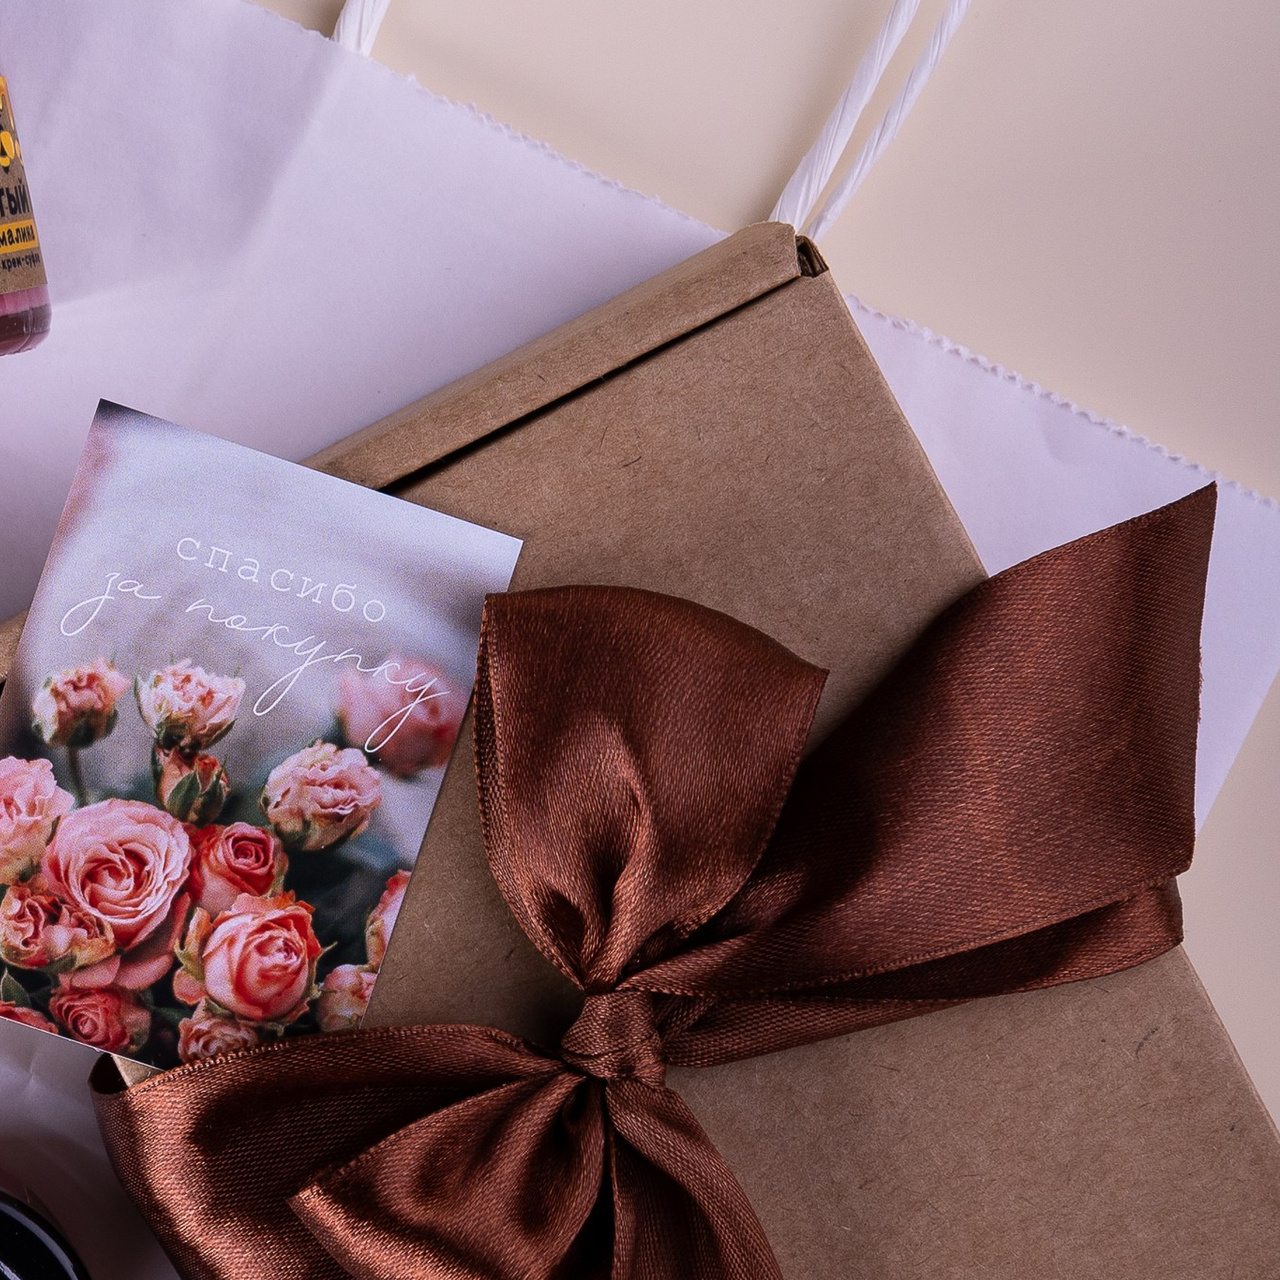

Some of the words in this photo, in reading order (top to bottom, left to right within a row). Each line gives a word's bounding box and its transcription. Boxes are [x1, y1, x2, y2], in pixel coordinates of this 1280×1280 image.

[176, 537, 386, 622] спасибо
[60, 572, 163, 636] за
[185, 597, 451, 753] покупку
